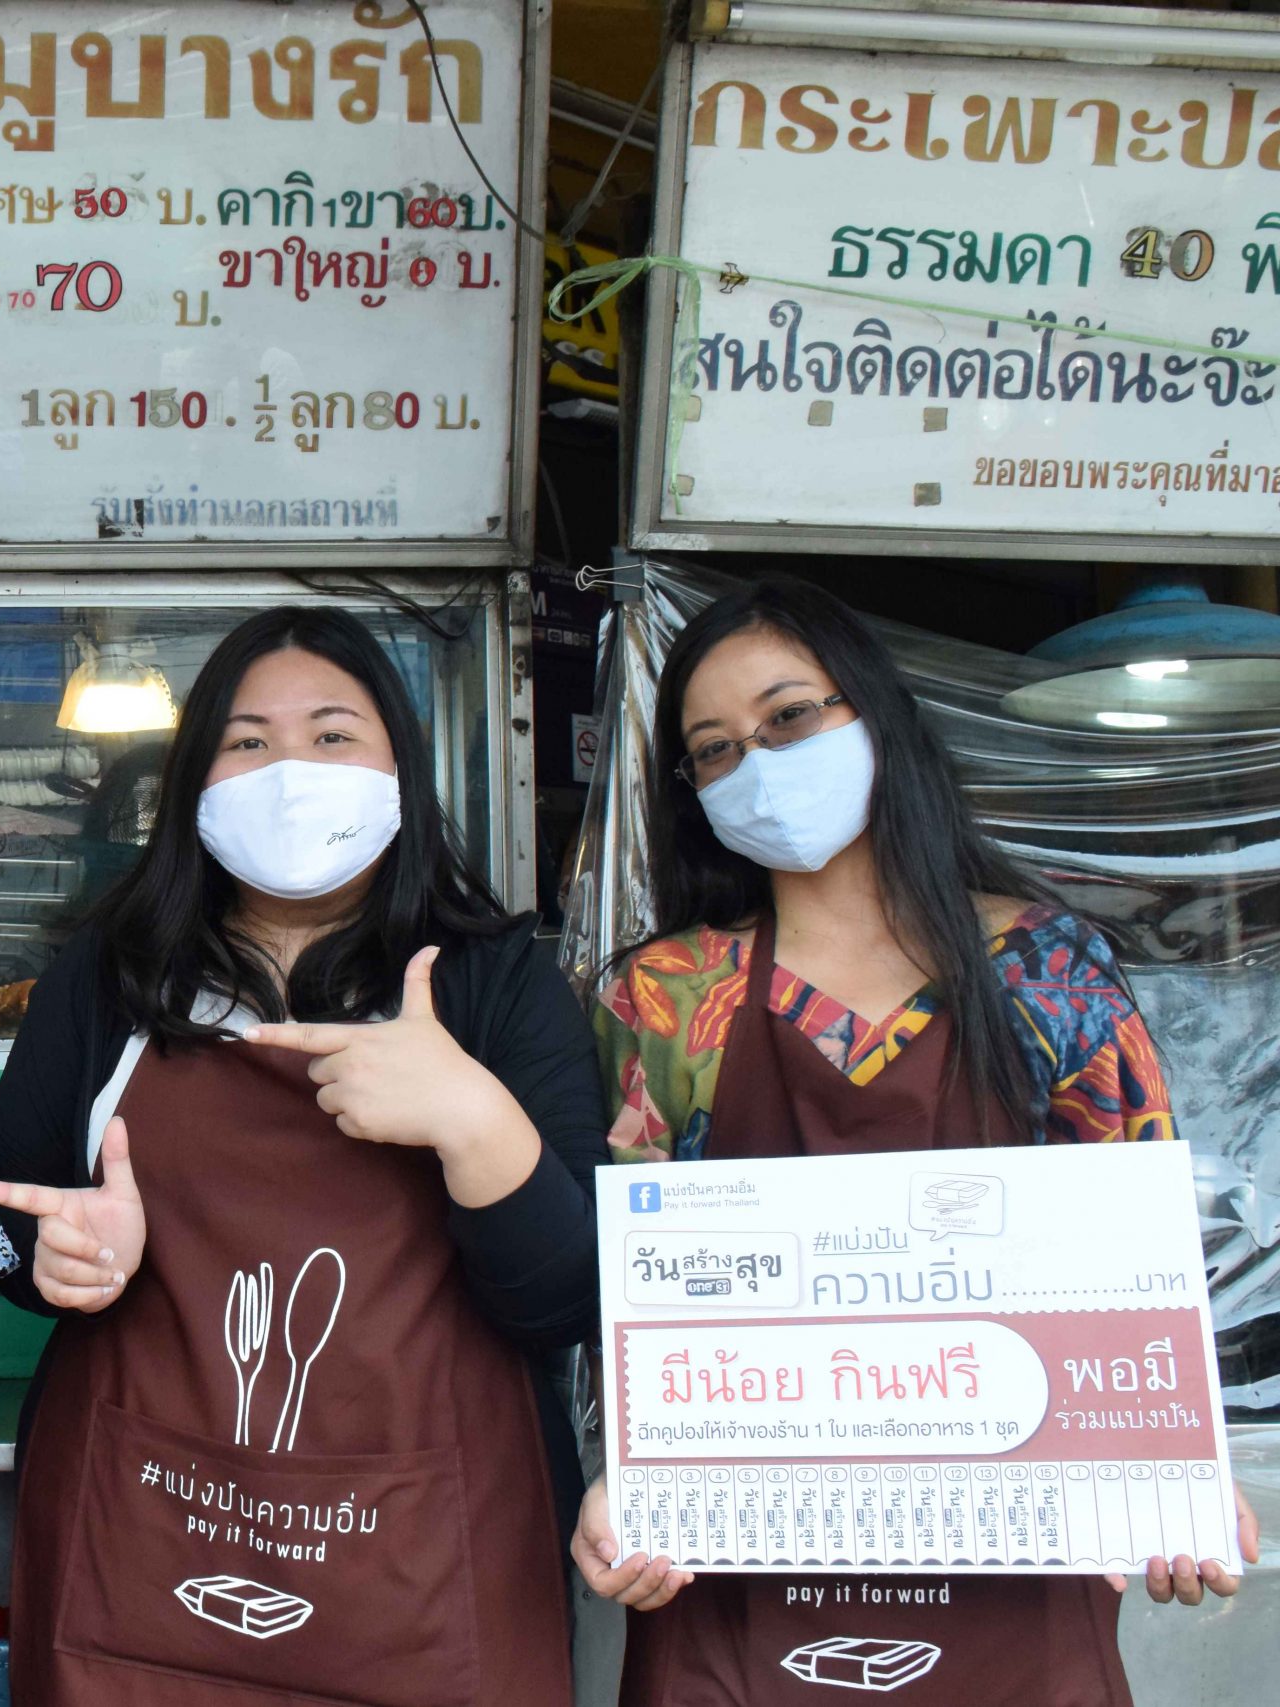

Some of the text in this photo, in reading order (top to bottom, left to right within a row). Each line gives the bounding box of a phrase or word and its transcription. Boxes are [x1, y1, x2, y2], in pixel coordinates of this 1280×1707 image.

[219, 236, 389, 308] ขาใหญ่
[457, 251, 501, 289] บ.
[828, 225, 1092, 288] ธรรมดา
[663, 1178, 756, 1197] แบ่งปันความอิ่ม
[813, 1248, 993, 1306] ความอิ่ม
[661, 1341, 982, 1405] มีน้อย กินฟรี
[1063, 1337, 1179, 1394] พอมี
[637, 1417, 810, 1446] ฉีกคูปองให้เจ้าของร้าน
[852, 1416, 975, 1438] และเลือกอาหาร
[1055, 1399, 1201, 1433] ร่วมแบ่งปัน
[140, 1460, 377, 1534] #แบ่งปันความอิ่ม
[187, 1515, 326, 1562] pay it forward
[787, 1582, 950, 1608] pay it forward
